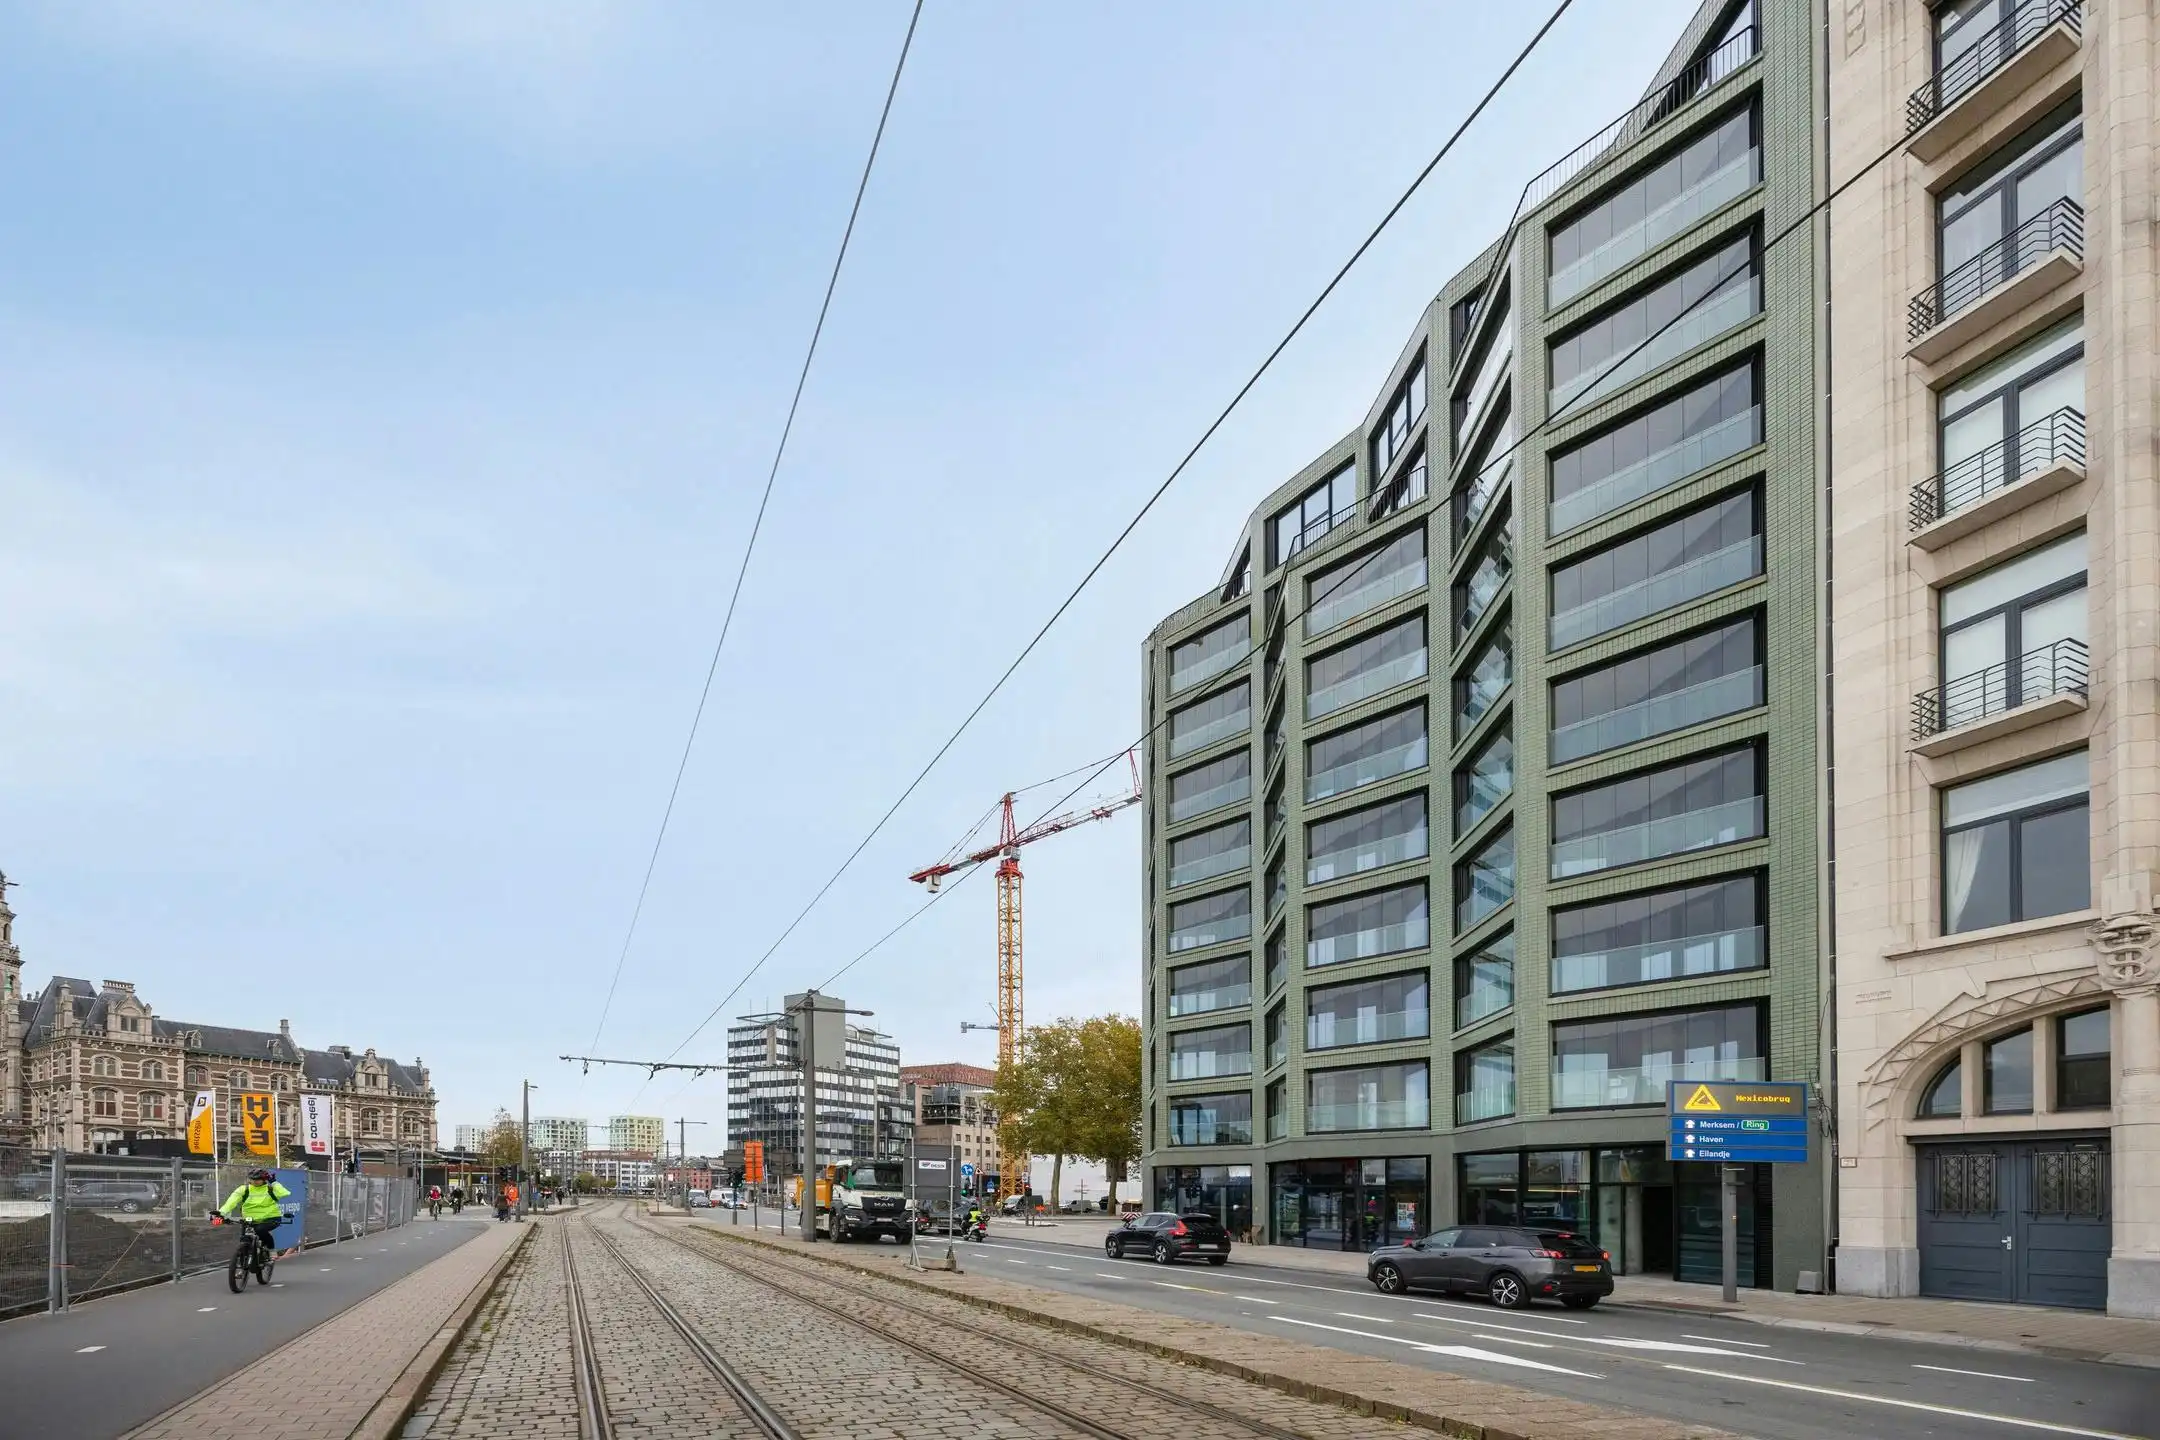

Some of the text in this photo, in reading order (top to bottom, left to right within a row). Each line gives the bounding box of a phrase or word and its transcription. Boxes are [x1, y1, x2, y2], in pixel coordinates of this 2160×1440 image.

[1700, 1121, 1735, 1129] Merksem
[1746, 1121, 1765, 1130] Ring
[1700, 1150, 1730, 1158] Eilandje
